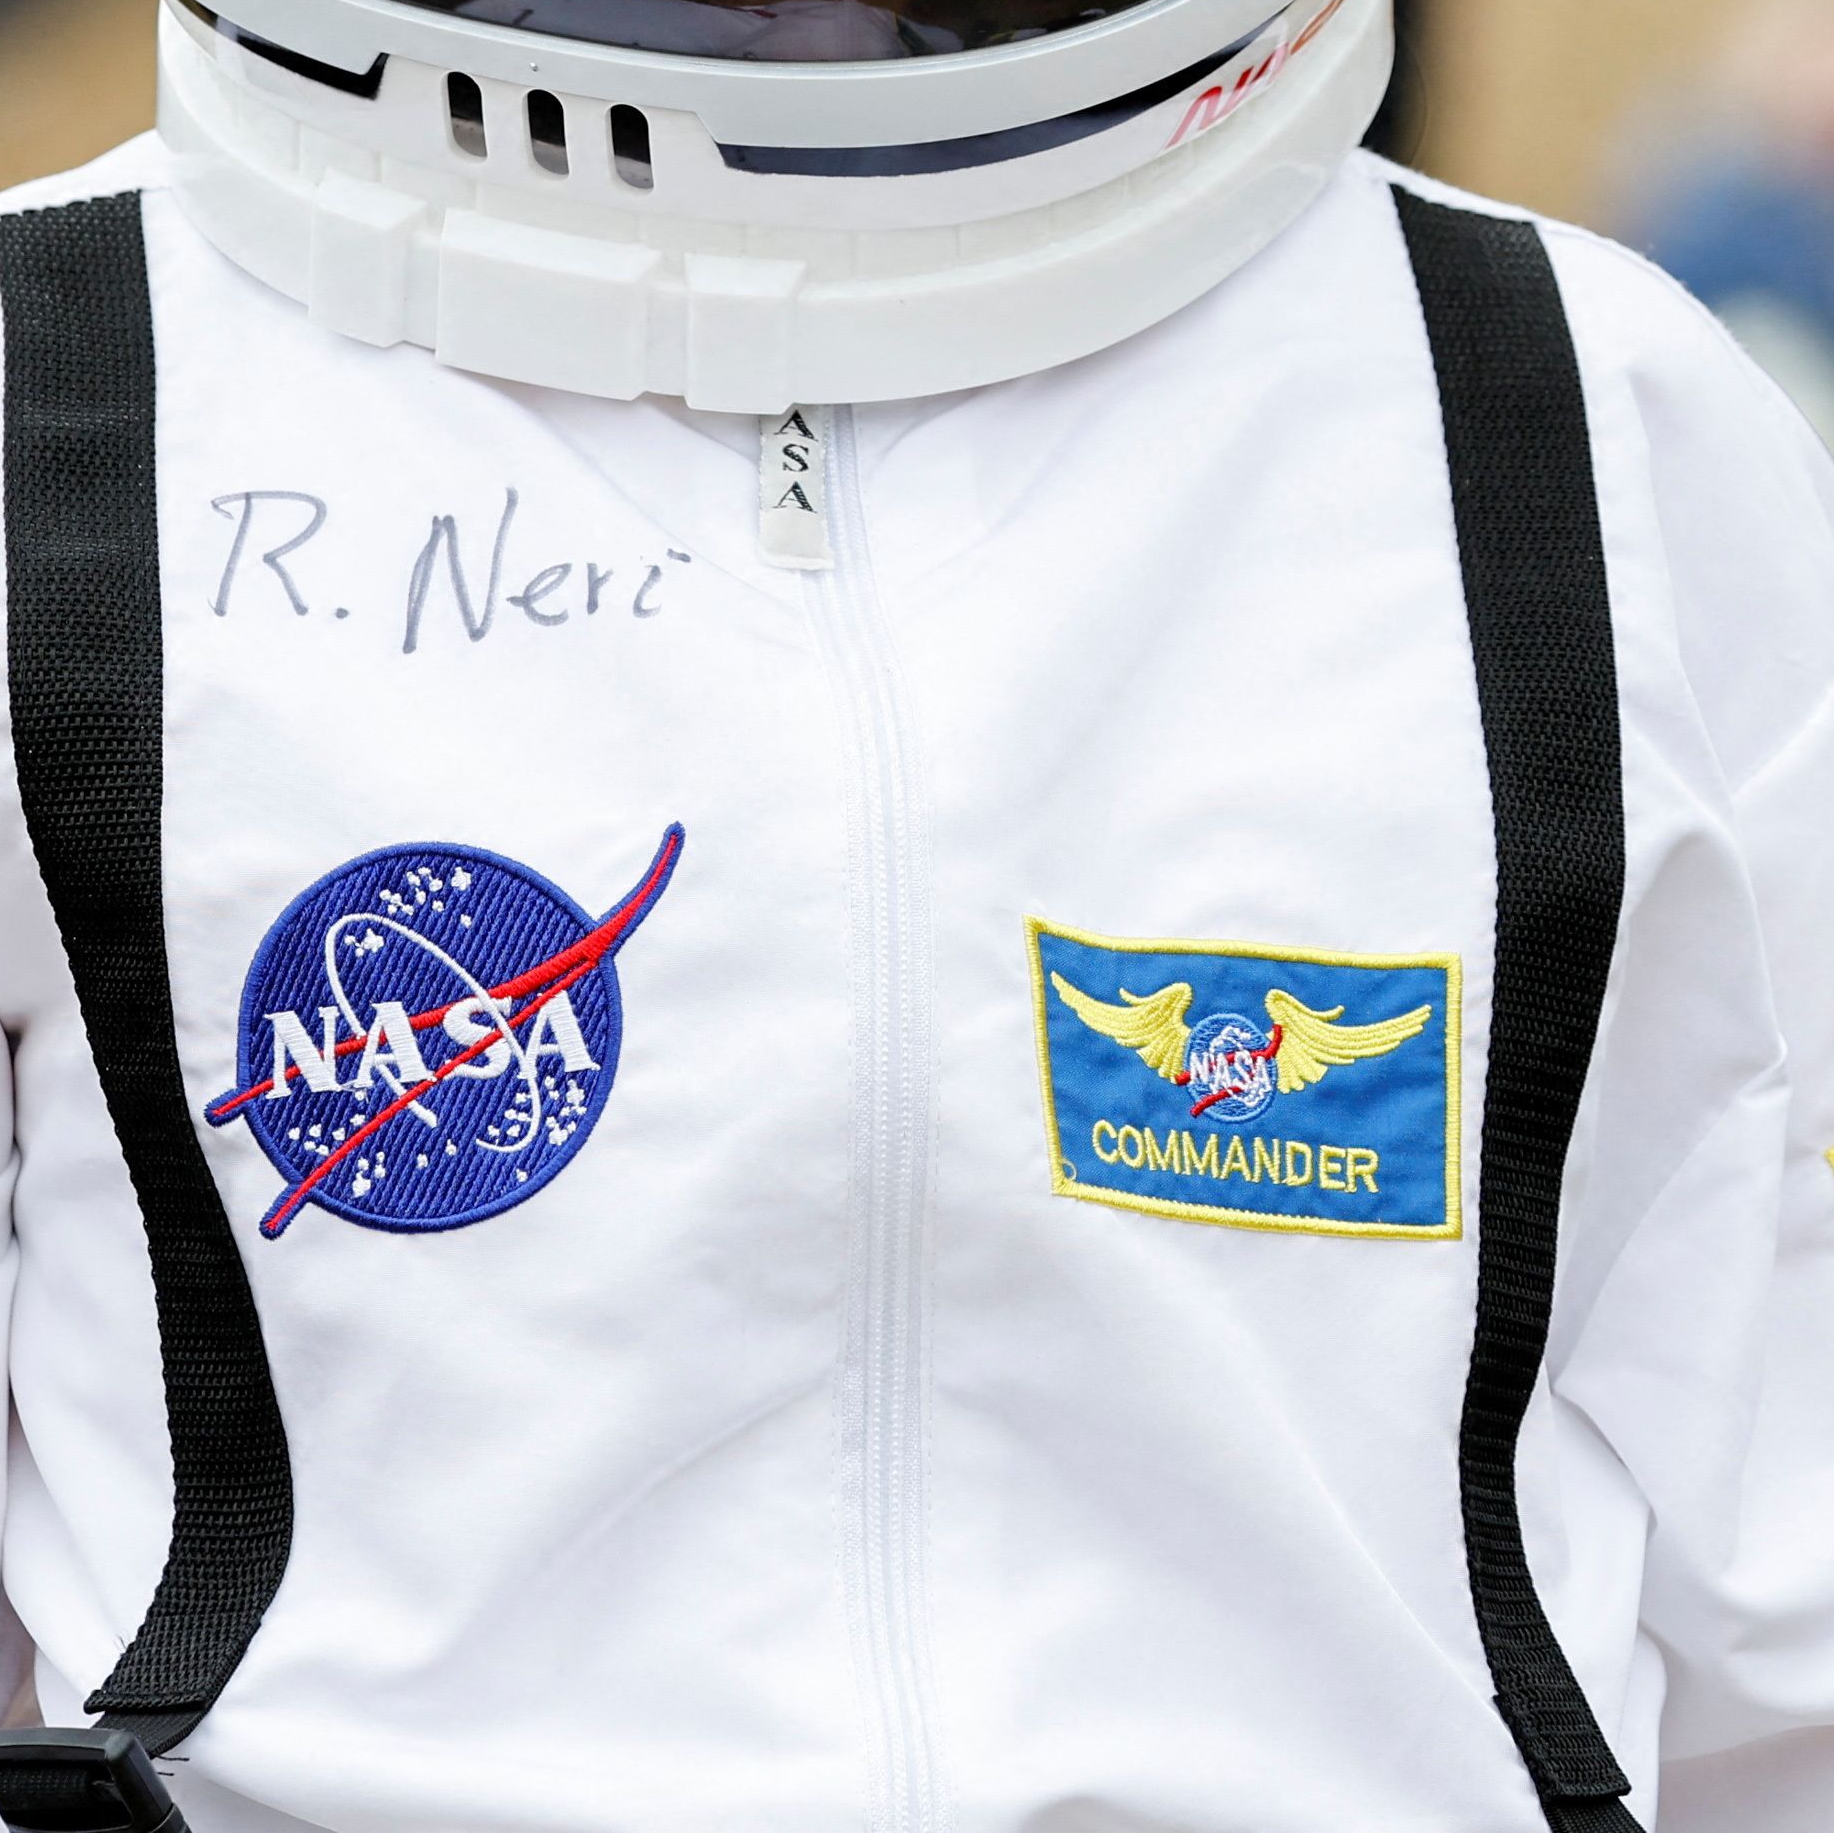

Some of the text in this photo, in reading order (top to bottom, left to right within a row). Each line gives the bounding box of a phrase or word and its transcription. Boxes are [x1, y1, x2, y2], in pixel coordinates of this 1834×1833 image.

[211, 486, 692, 655] R. Neri
[264, 991, 601, 1100] NASA
[1189, 1049, 1272, 1095] NASA
[1091, 1119, 1380, 1194] COMMANDER
